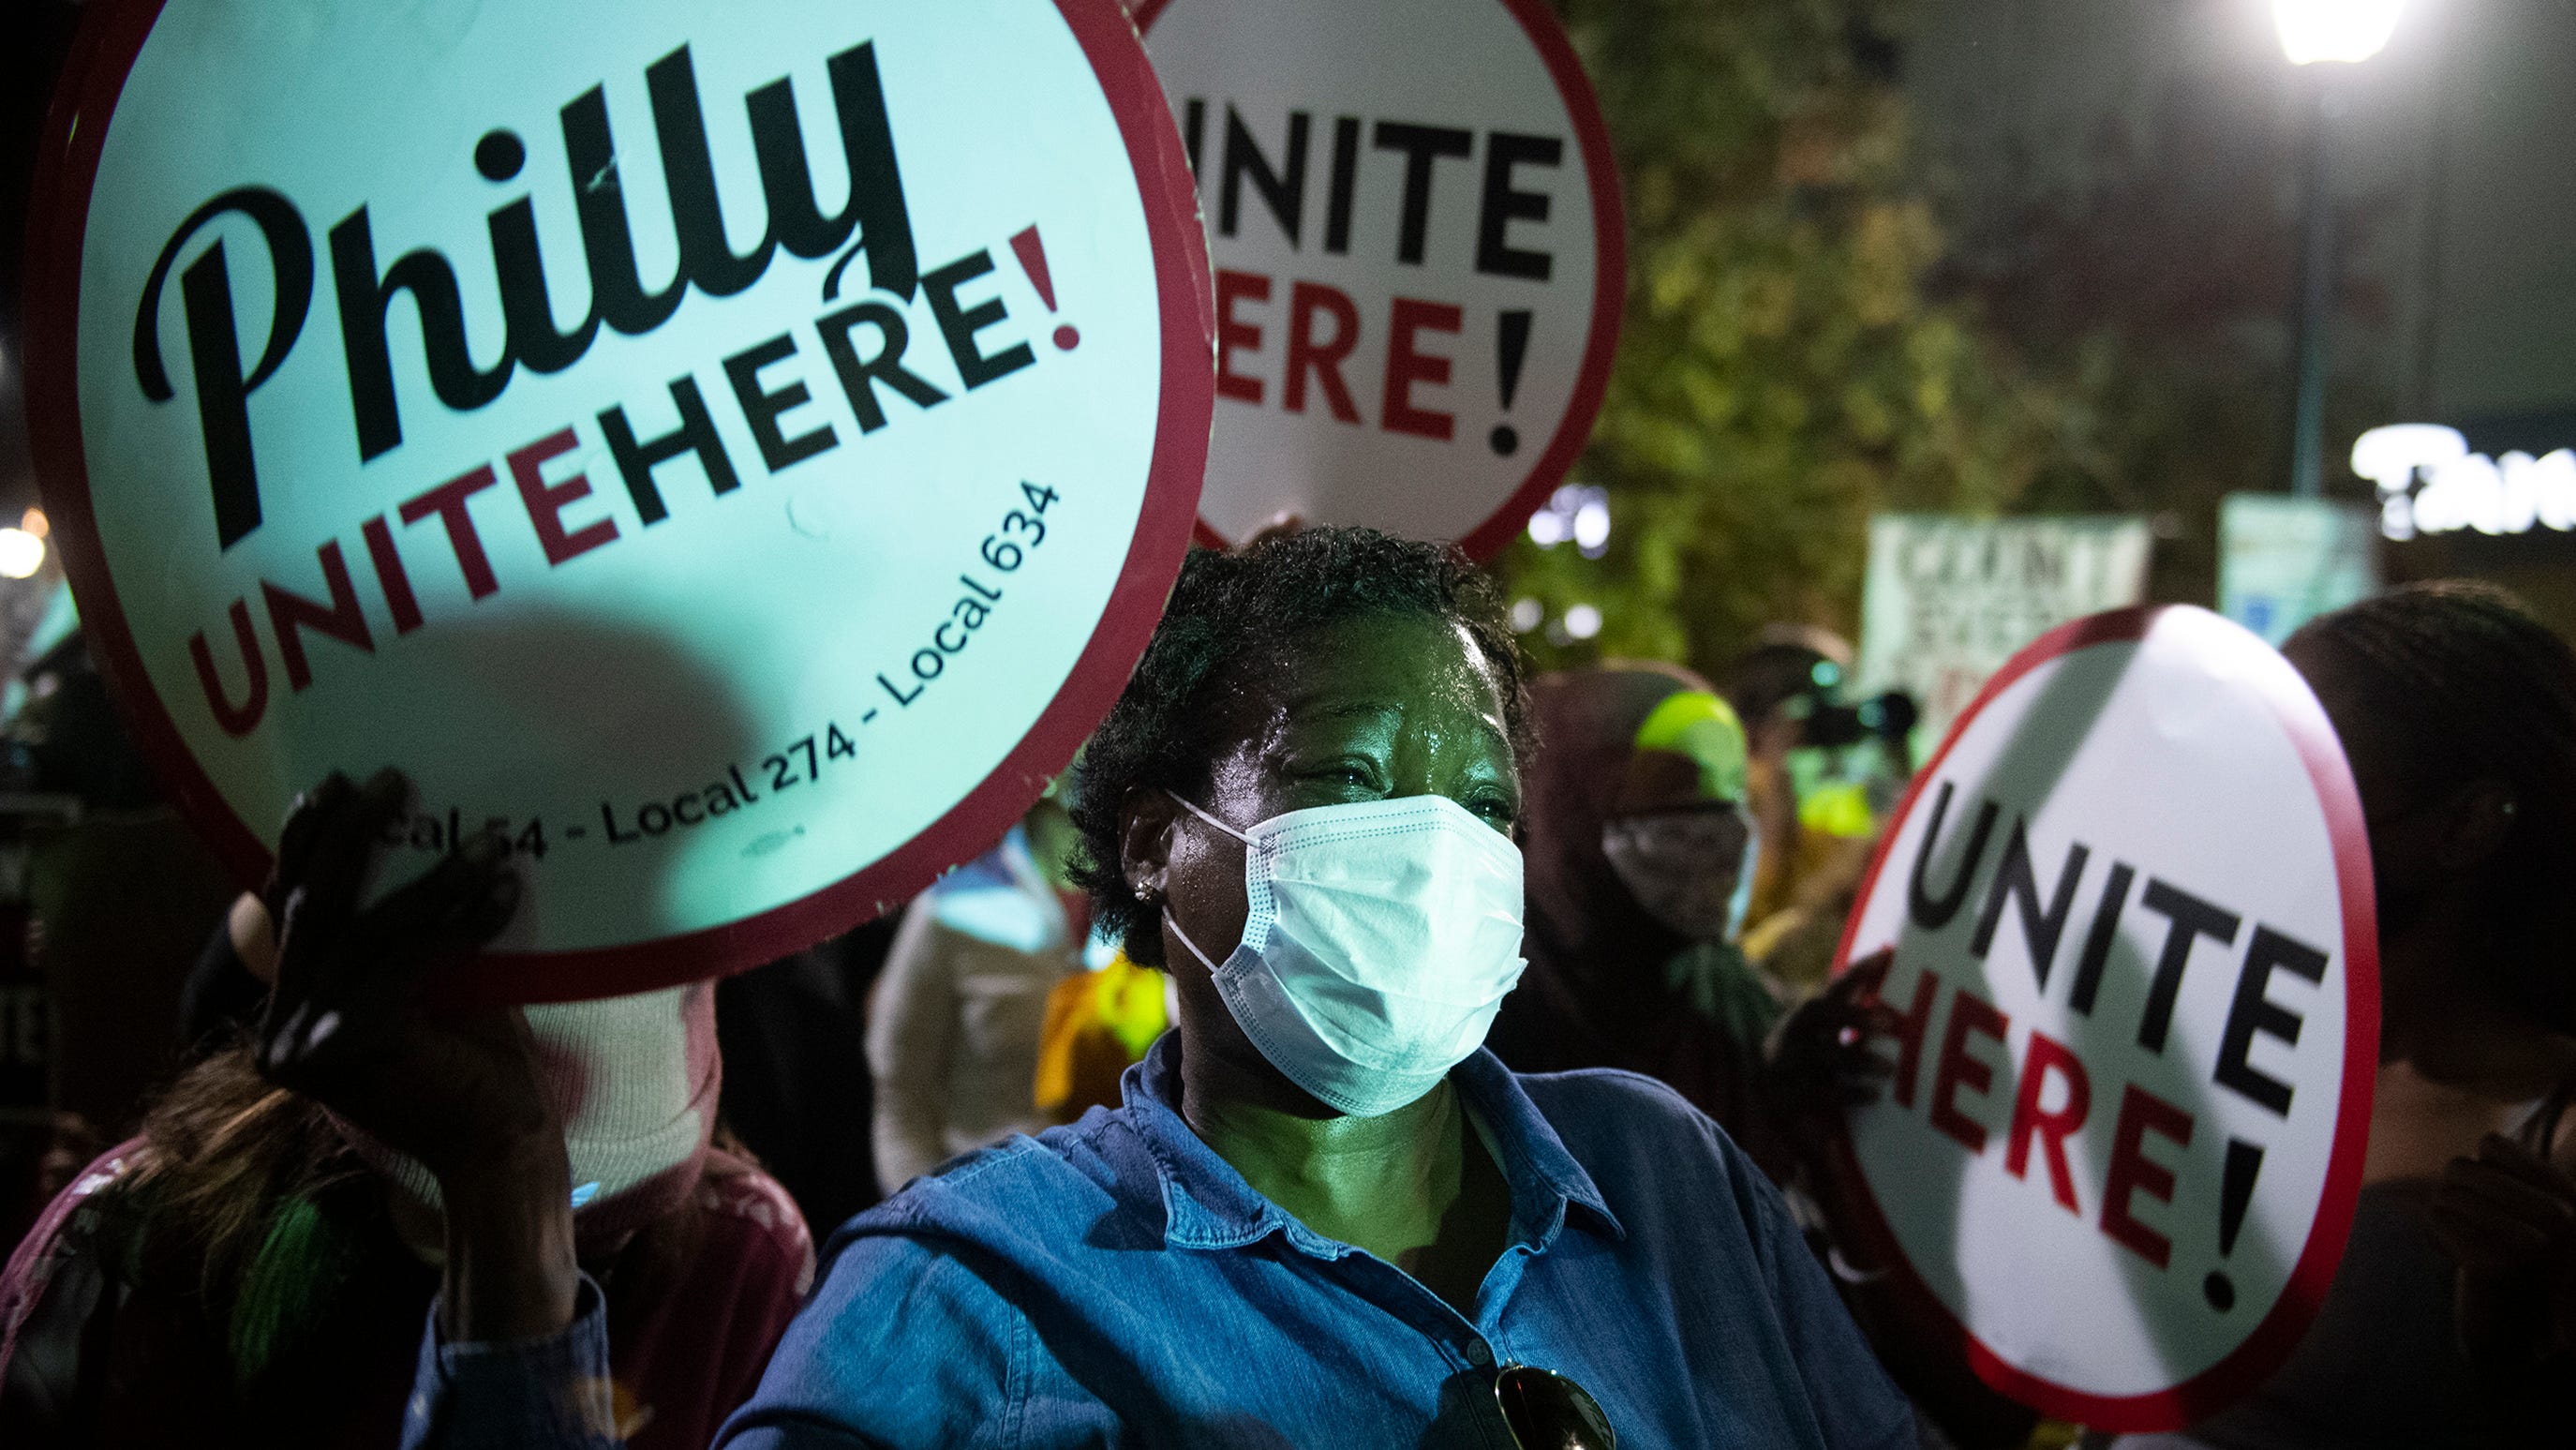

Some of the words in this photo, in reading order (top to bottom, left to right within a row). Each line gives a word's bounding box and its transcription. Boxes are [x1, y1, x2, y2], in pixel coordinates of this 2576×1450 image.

[133, 38, 918, 553] Philly
[1214, 266, 1533, 457] ERE!
[601, 764, 759, 845] Local
[761, 720, 856, 792] 274
[876, 574, 1003, 707] Local
[981, 479, 1060, 573] 634
[1907, 780, 2330, 1119] UNITE
